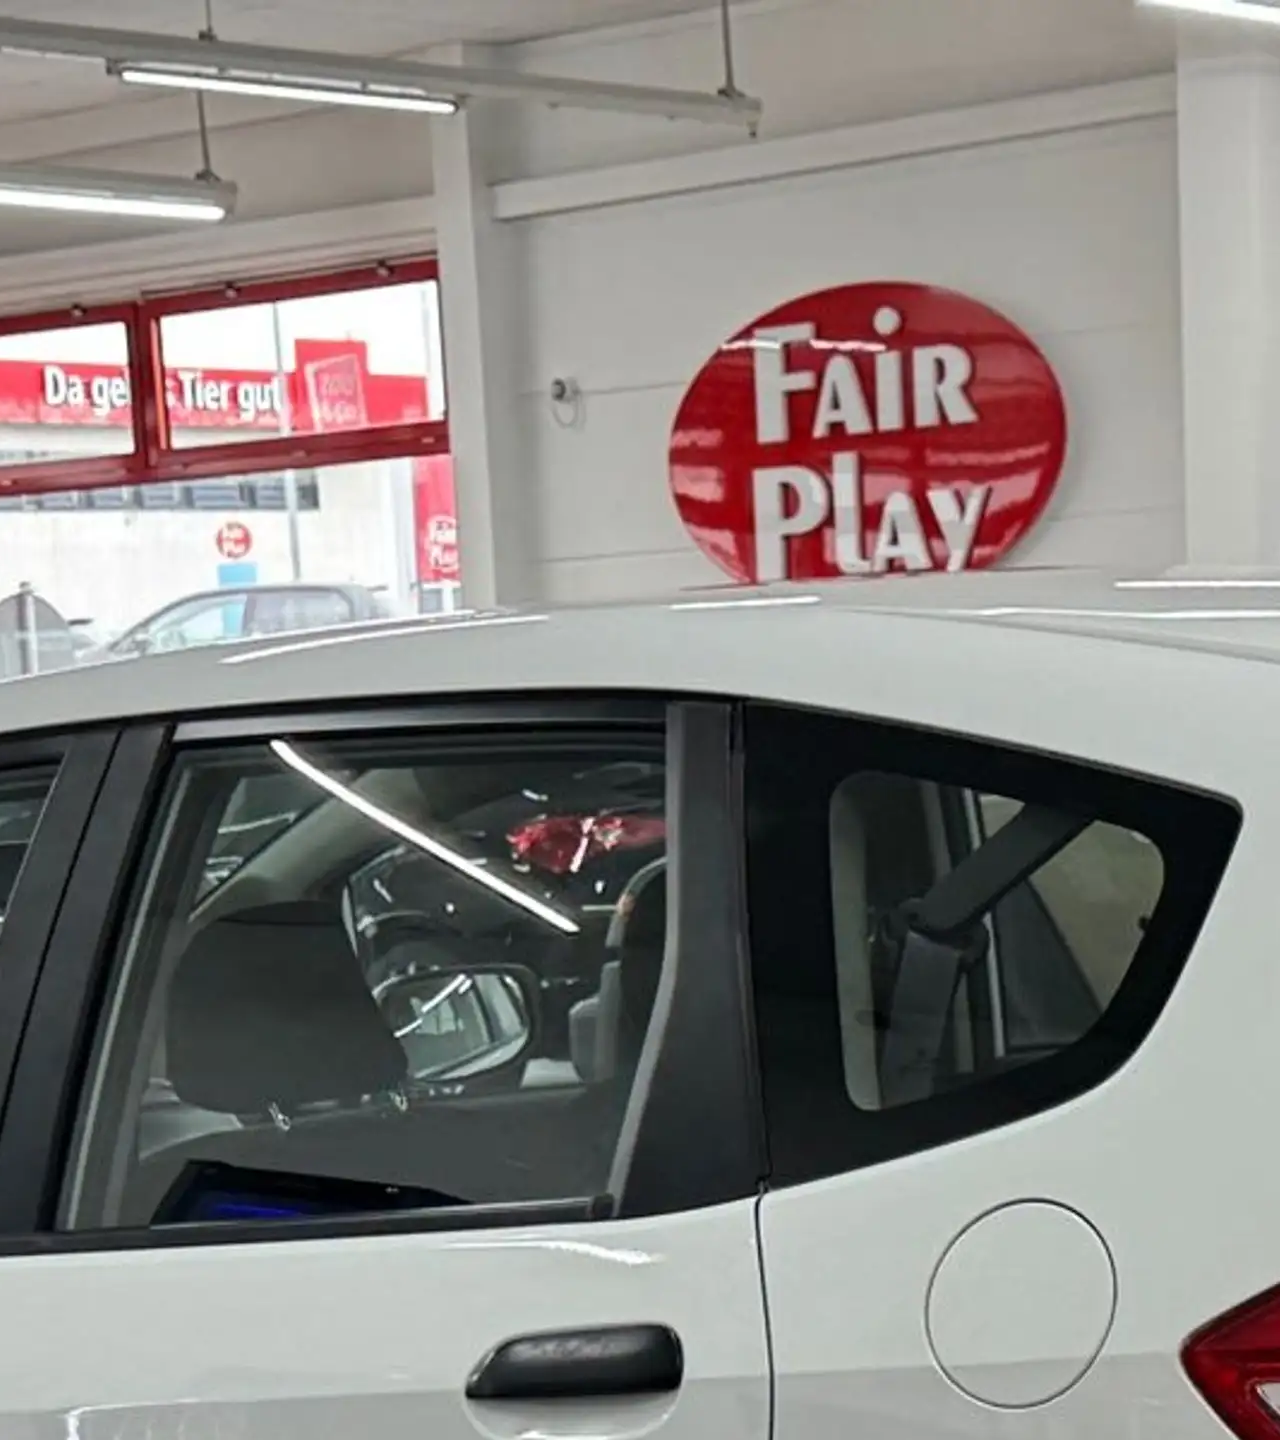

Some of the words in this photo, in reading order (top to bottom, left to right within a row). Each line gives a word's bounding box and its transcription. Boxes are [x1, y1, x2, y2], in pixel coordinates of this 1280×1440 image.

[43, 366, 84, 406] Da
[178, 370, 230, 412] Tier
[237, 376, 283, 422] gut
